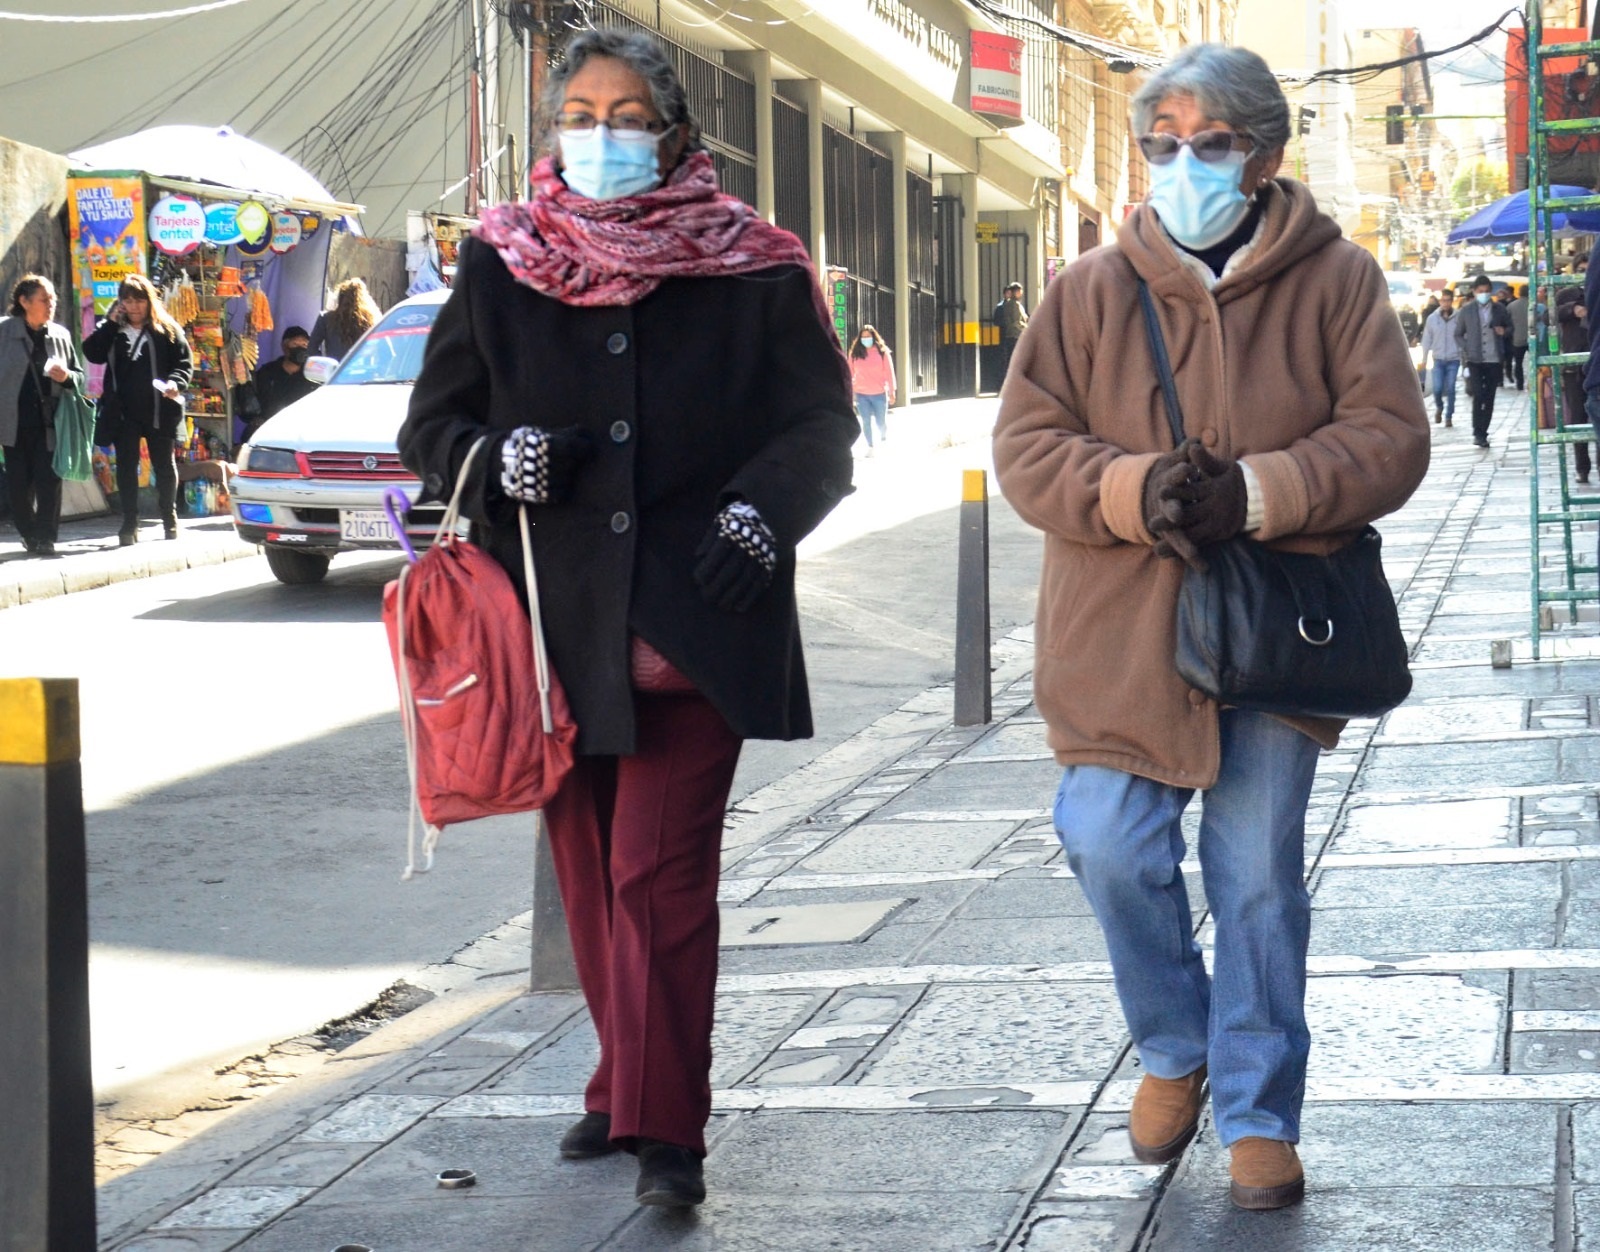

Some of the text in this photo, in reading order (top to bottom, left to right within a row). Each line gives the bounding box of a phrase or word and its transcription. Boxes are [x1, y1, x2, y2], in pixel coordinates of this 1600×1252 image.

[87, 211, 100, 221] TU
[155, 216, 200, 228] Tarjetas
[160, 229, 193, 239] entel
[97, 285, 119, 295] ent
[345, 520, 394, 538] 2106TT
